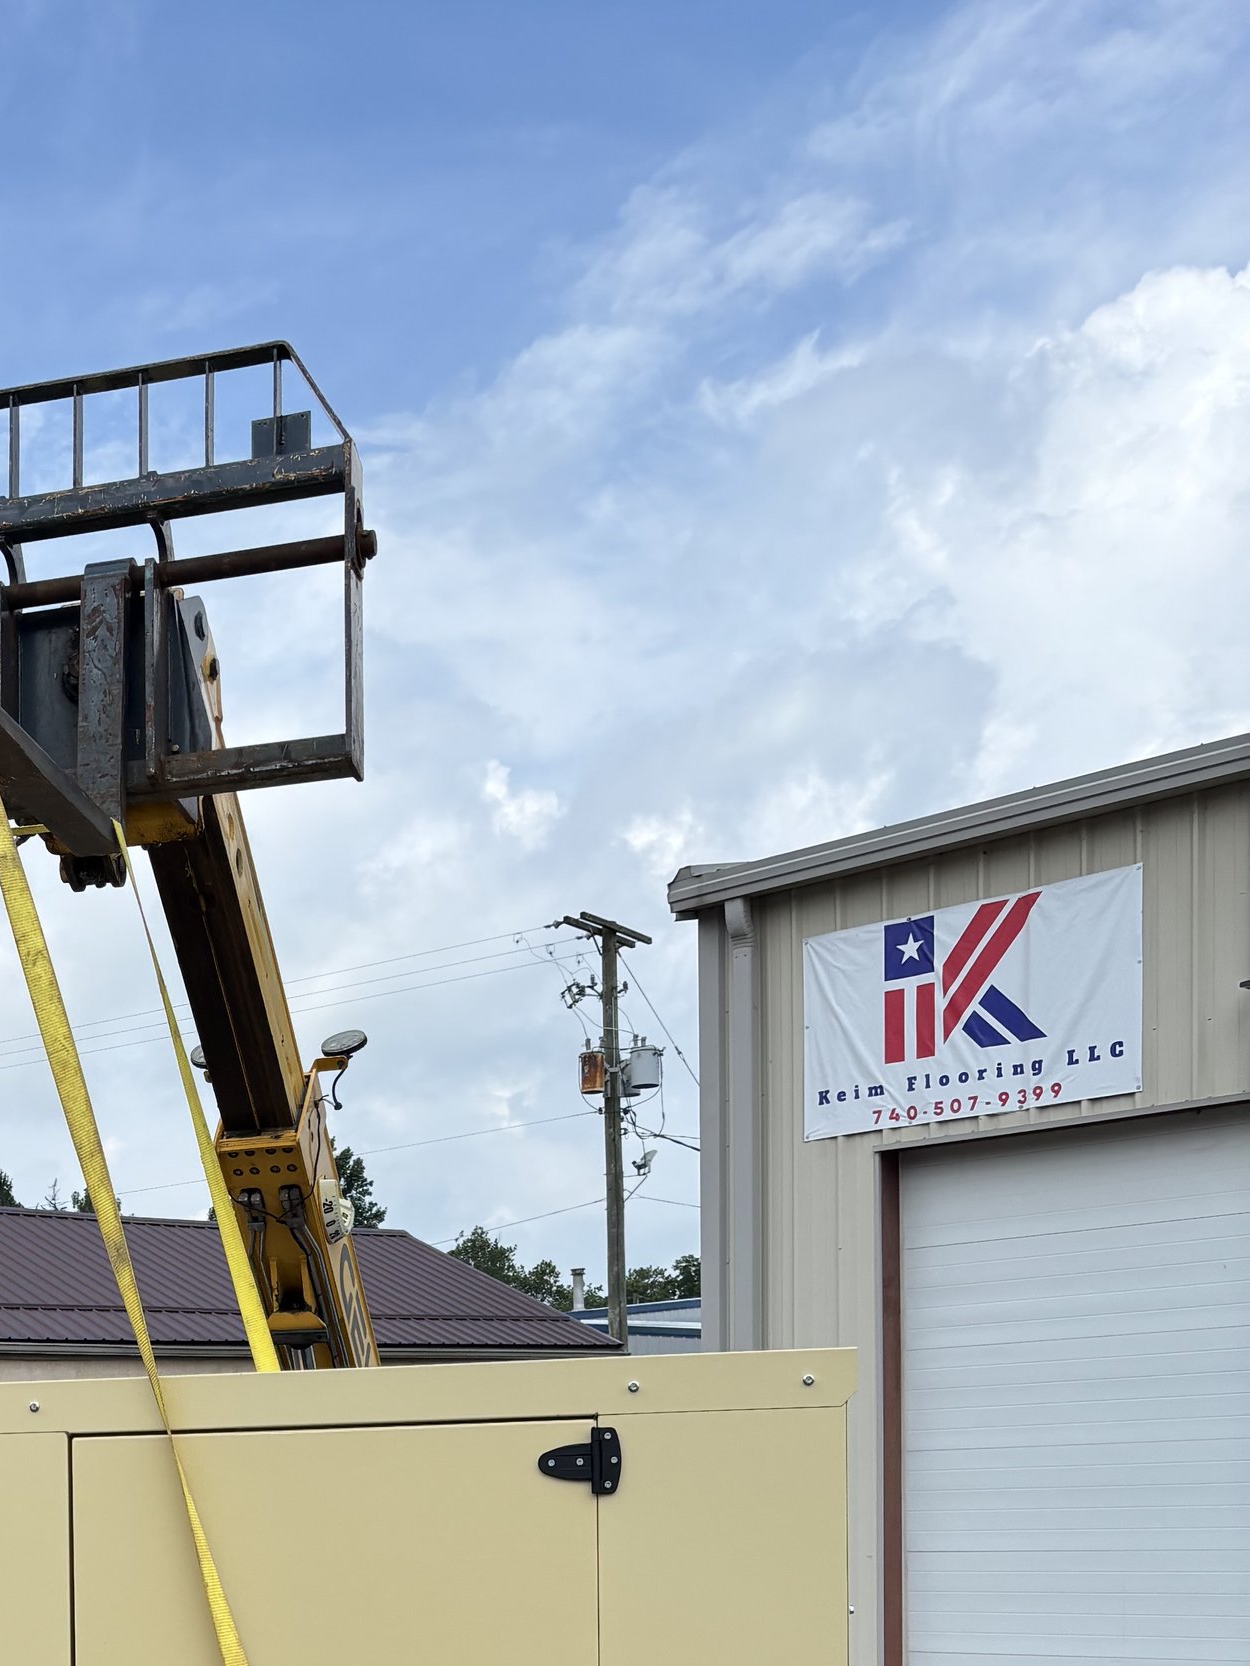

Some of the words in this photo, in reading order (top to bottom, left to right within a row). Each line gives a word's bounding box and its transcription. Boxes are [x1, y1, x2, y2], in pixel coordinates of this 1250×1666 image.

[817, 1083, 885, 1105] Keim
[906, 1058, 1043, 1092] Flooring
[1066, 1040, 1124, 1066] LLC
[872, 1082, 1062, 1125] 740-507-9399
